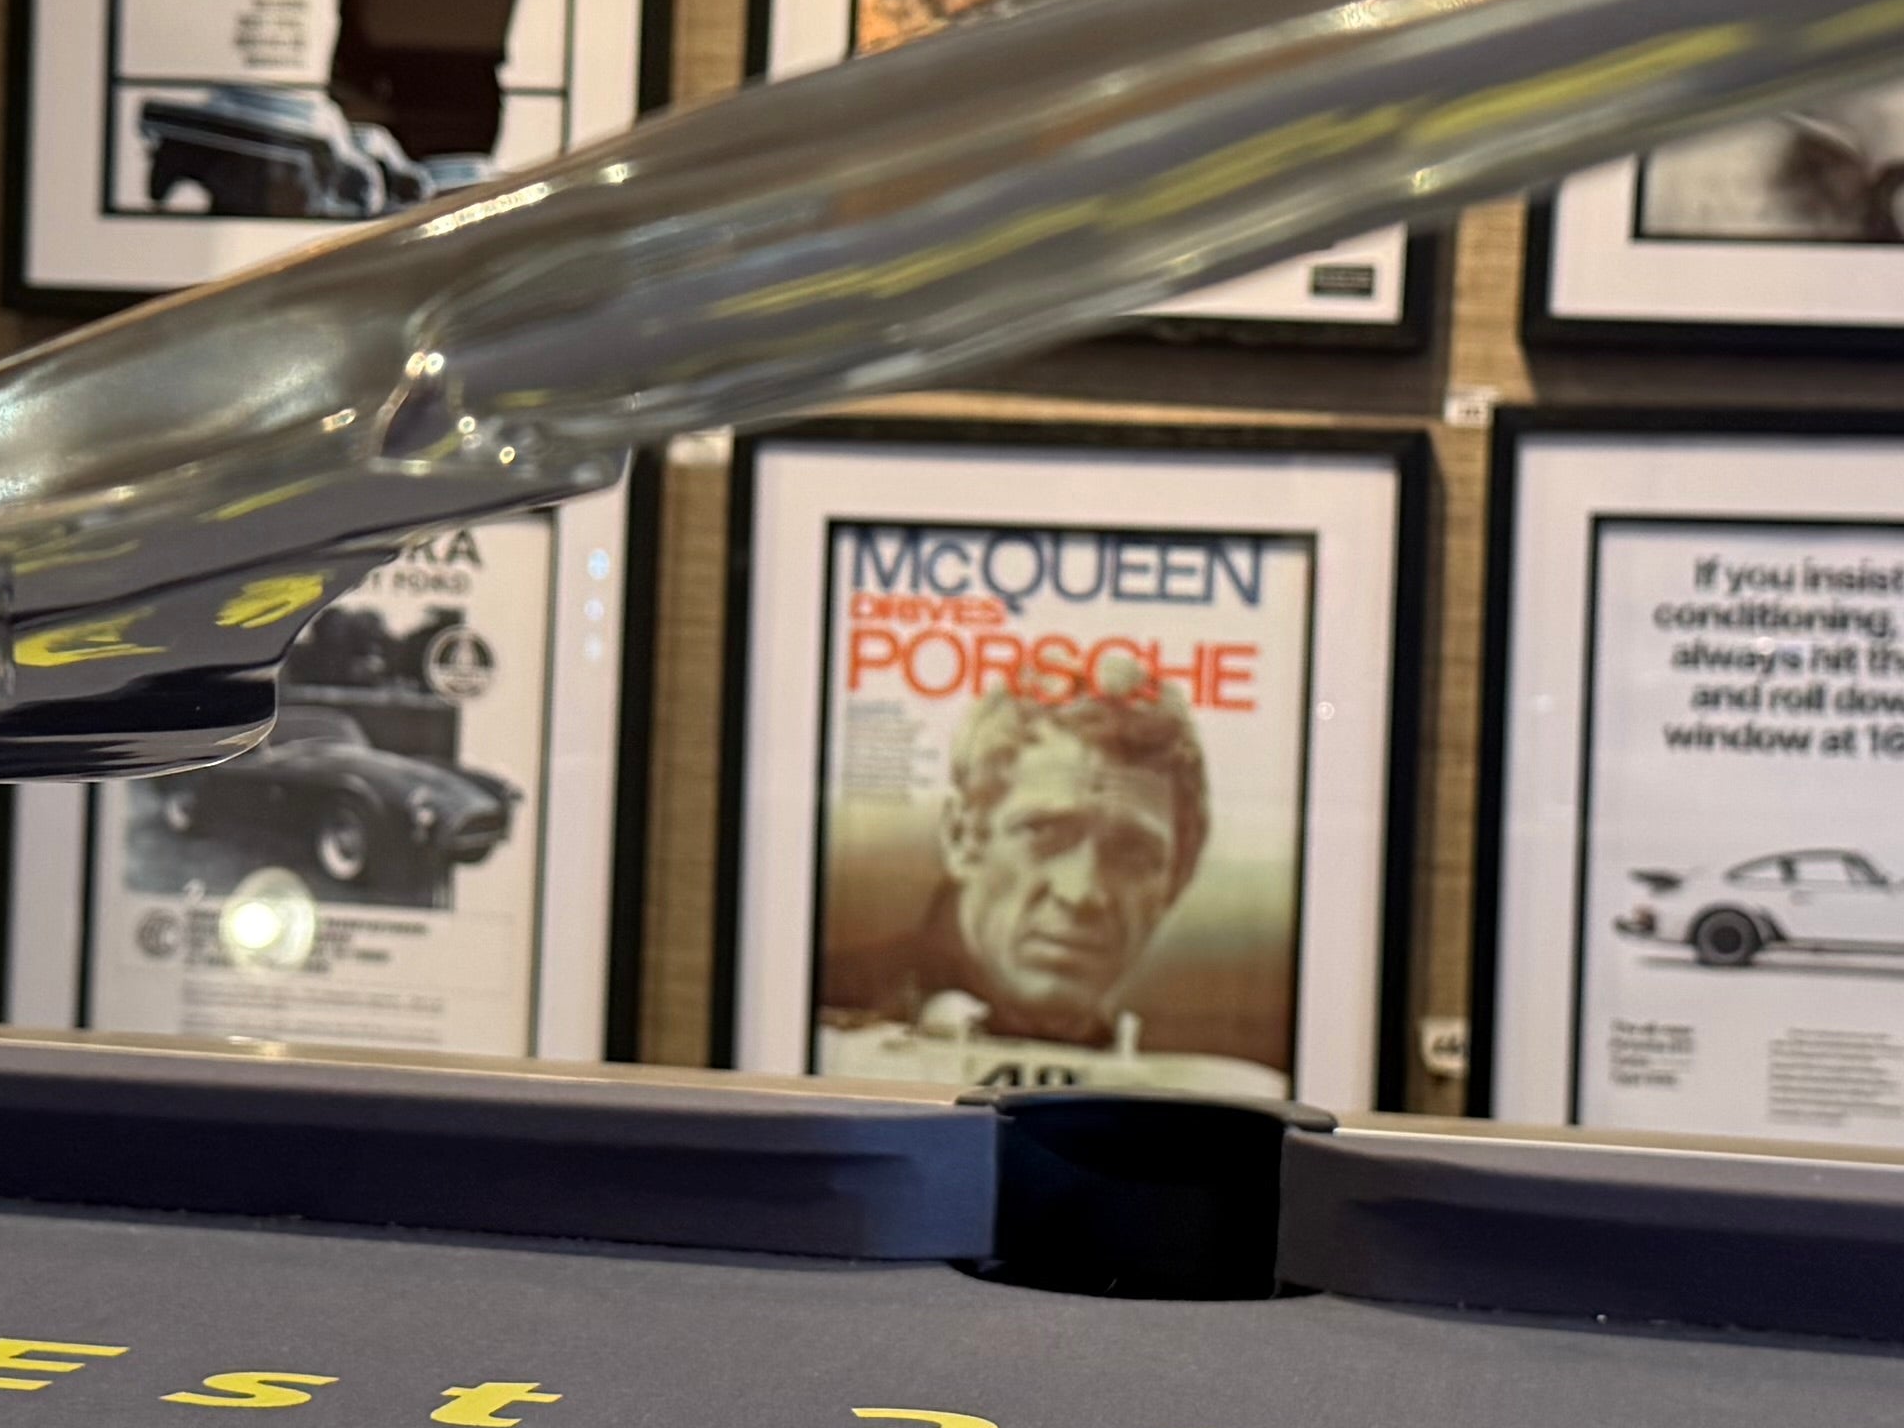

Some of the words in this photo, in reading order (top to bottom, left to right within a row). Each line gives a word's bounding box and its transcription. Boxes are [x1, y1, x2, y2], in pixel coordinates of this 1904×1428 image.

[1725, 563, 1796, 594] you
[849, 592, 1007, 627] DRIVES
[847, 627, 1262, 712] PORSCHE
[1671, 640, 1806, 678] always
[1810, 642, 1859, 671] hit
[1691, 682, 1763, 712] and
[1768, 683, 1827, 713] roll
[1662, 721, 1813, 752] window
[1820, 727, 1857, 754] at
